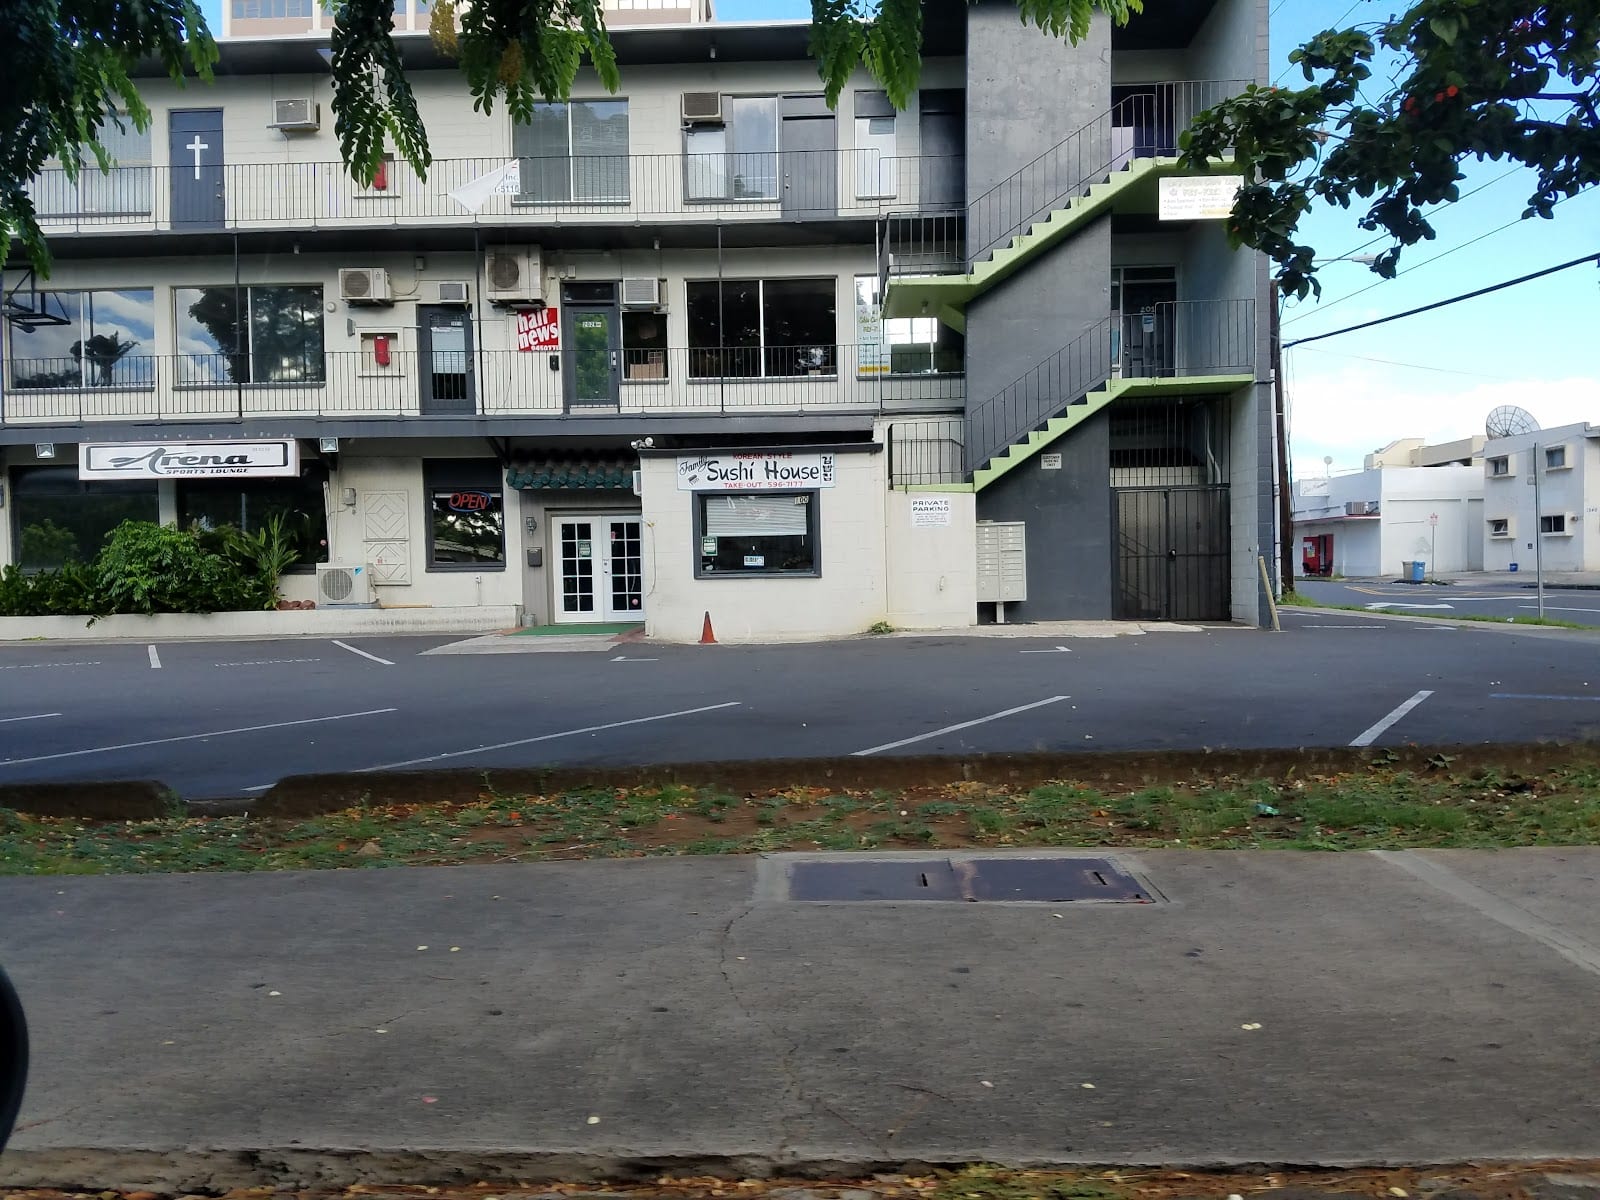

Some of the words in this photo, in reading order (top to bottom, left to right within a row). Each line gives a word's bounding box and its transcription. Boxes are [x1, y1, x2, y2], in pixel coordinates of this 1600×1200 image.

[517, 308, 549, 333] hair
[518, 322, 559, 349] news
[109, 447, 253, 474] Arena
[679, 456, 709, 475] Family
[732, 452, 763, 460] KOREAN
[706, 460, 755, 482] Sushi
[764, 460, 820, 480] House
[768, 480, 804, 488] 596-7177
[449, 493, 488, 509] OPEN
